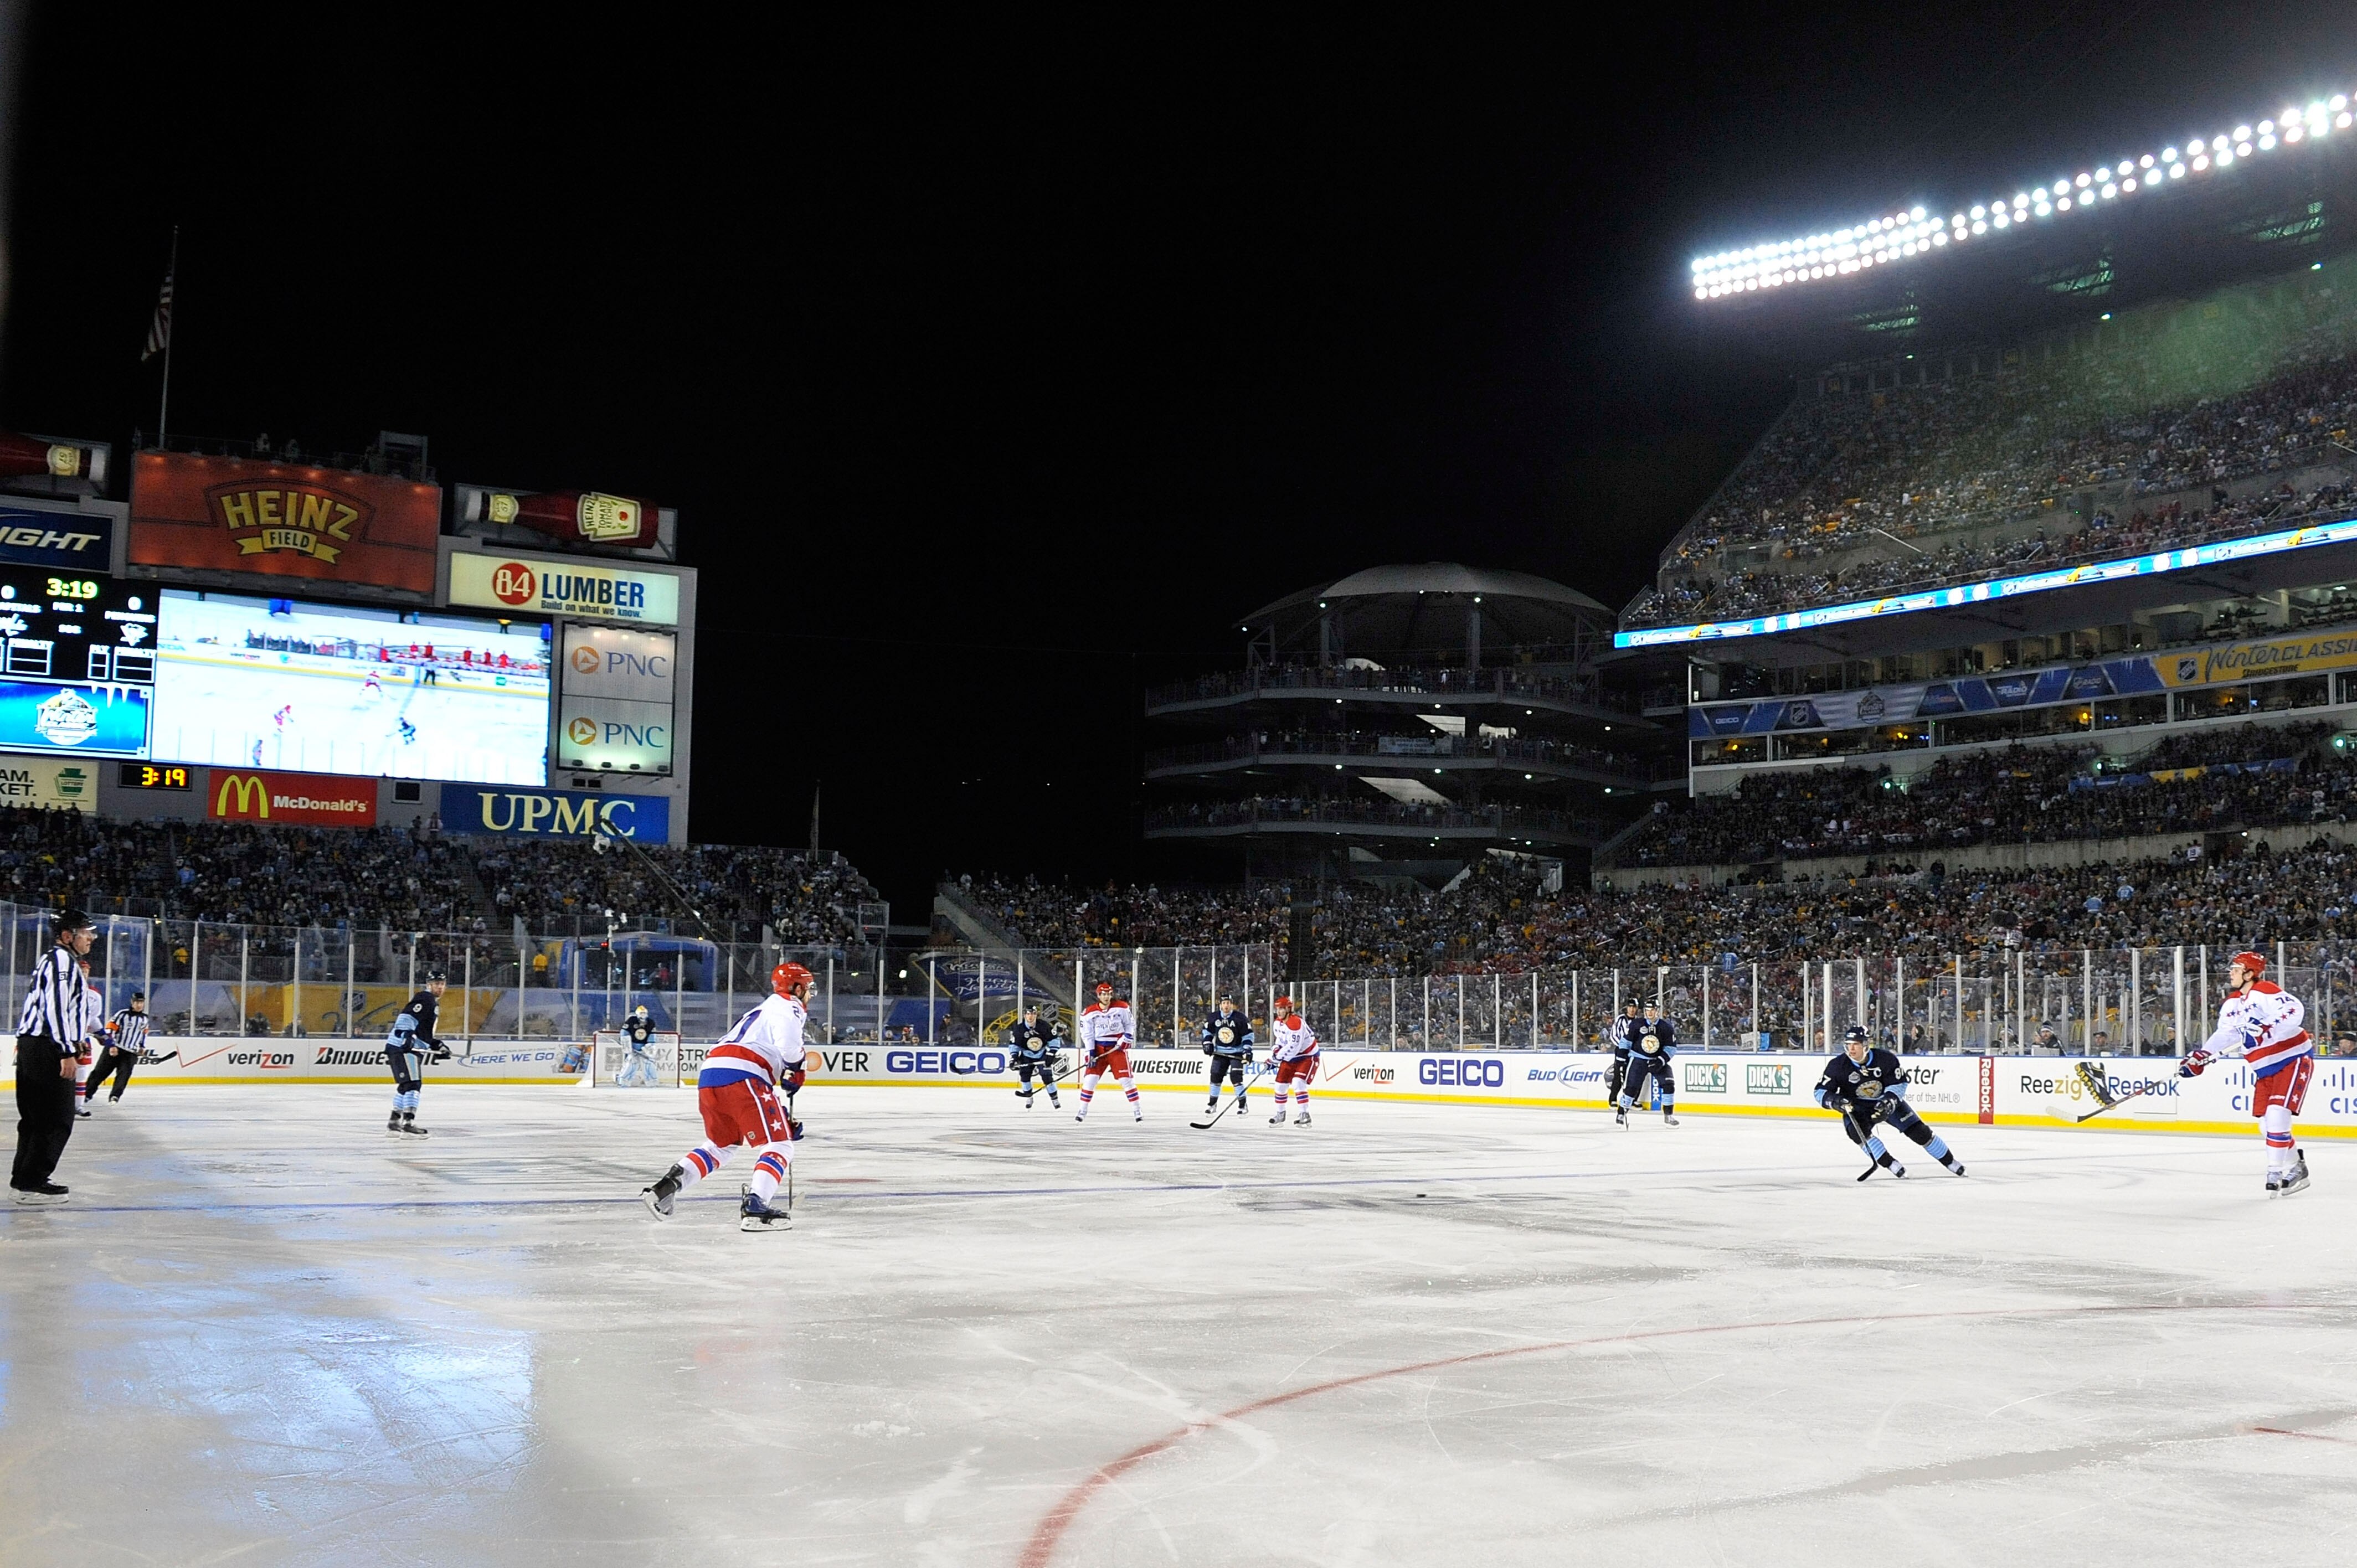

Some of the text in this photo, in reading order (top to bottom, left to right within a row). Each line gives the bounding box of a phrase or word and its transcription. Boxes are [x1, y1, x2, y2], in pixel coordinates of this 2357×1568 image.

[220, 491, 358, 541] HEINZ
[585, 500, 596, 527] HEINZ
[269, 532, 310, 548] FIELD
[47, 578, 98, 599] 3:19
[496, 569, 644, 607] 84 LUMBER
[128, 596, 142, 610] 0
[541, 600, 563, 610] Build
[565, 604, 576, 612] on
[578, 604, 599, 615] what
[606, 651, 667, 678] PNC
[2243, 664, 2298, 678] BRIDGESTONE
[602, 722, 664, 747] PNC
[142, 767, 186, 786] 3:19
[274, 795, 367, 813] McDonald's
[477, 792, 635, 837] UPMC
[413, 1003, 422, 1013] 9
[228, 1050, 294, 1068] verizon
[471, 1053, 554, 1064] HERE WE GO
[886, 1051, 1000, 1074] GEICO
[1133, 1060, 1203, 1074] IDGESTONE
[1354, 1064, 1394, 1084] verizon
[1419, 1059, 1504, 1087] GEICO
[1527, 1069, 1603, 1082] BUD LIGHT
[1687, 1065, 1726, 1086] DICK'S
[1748, 1066, 1789, 1087] DICK'S
[1980, 1059, 1992, 1113] Reebok
[2021, 1075, 2082, 1101] Reezig
[2108, 1076, 2180, 1097] Reebok
[1917, 1092, 1923, 1102] of
[1925, 1093, 1936, 1102] the
